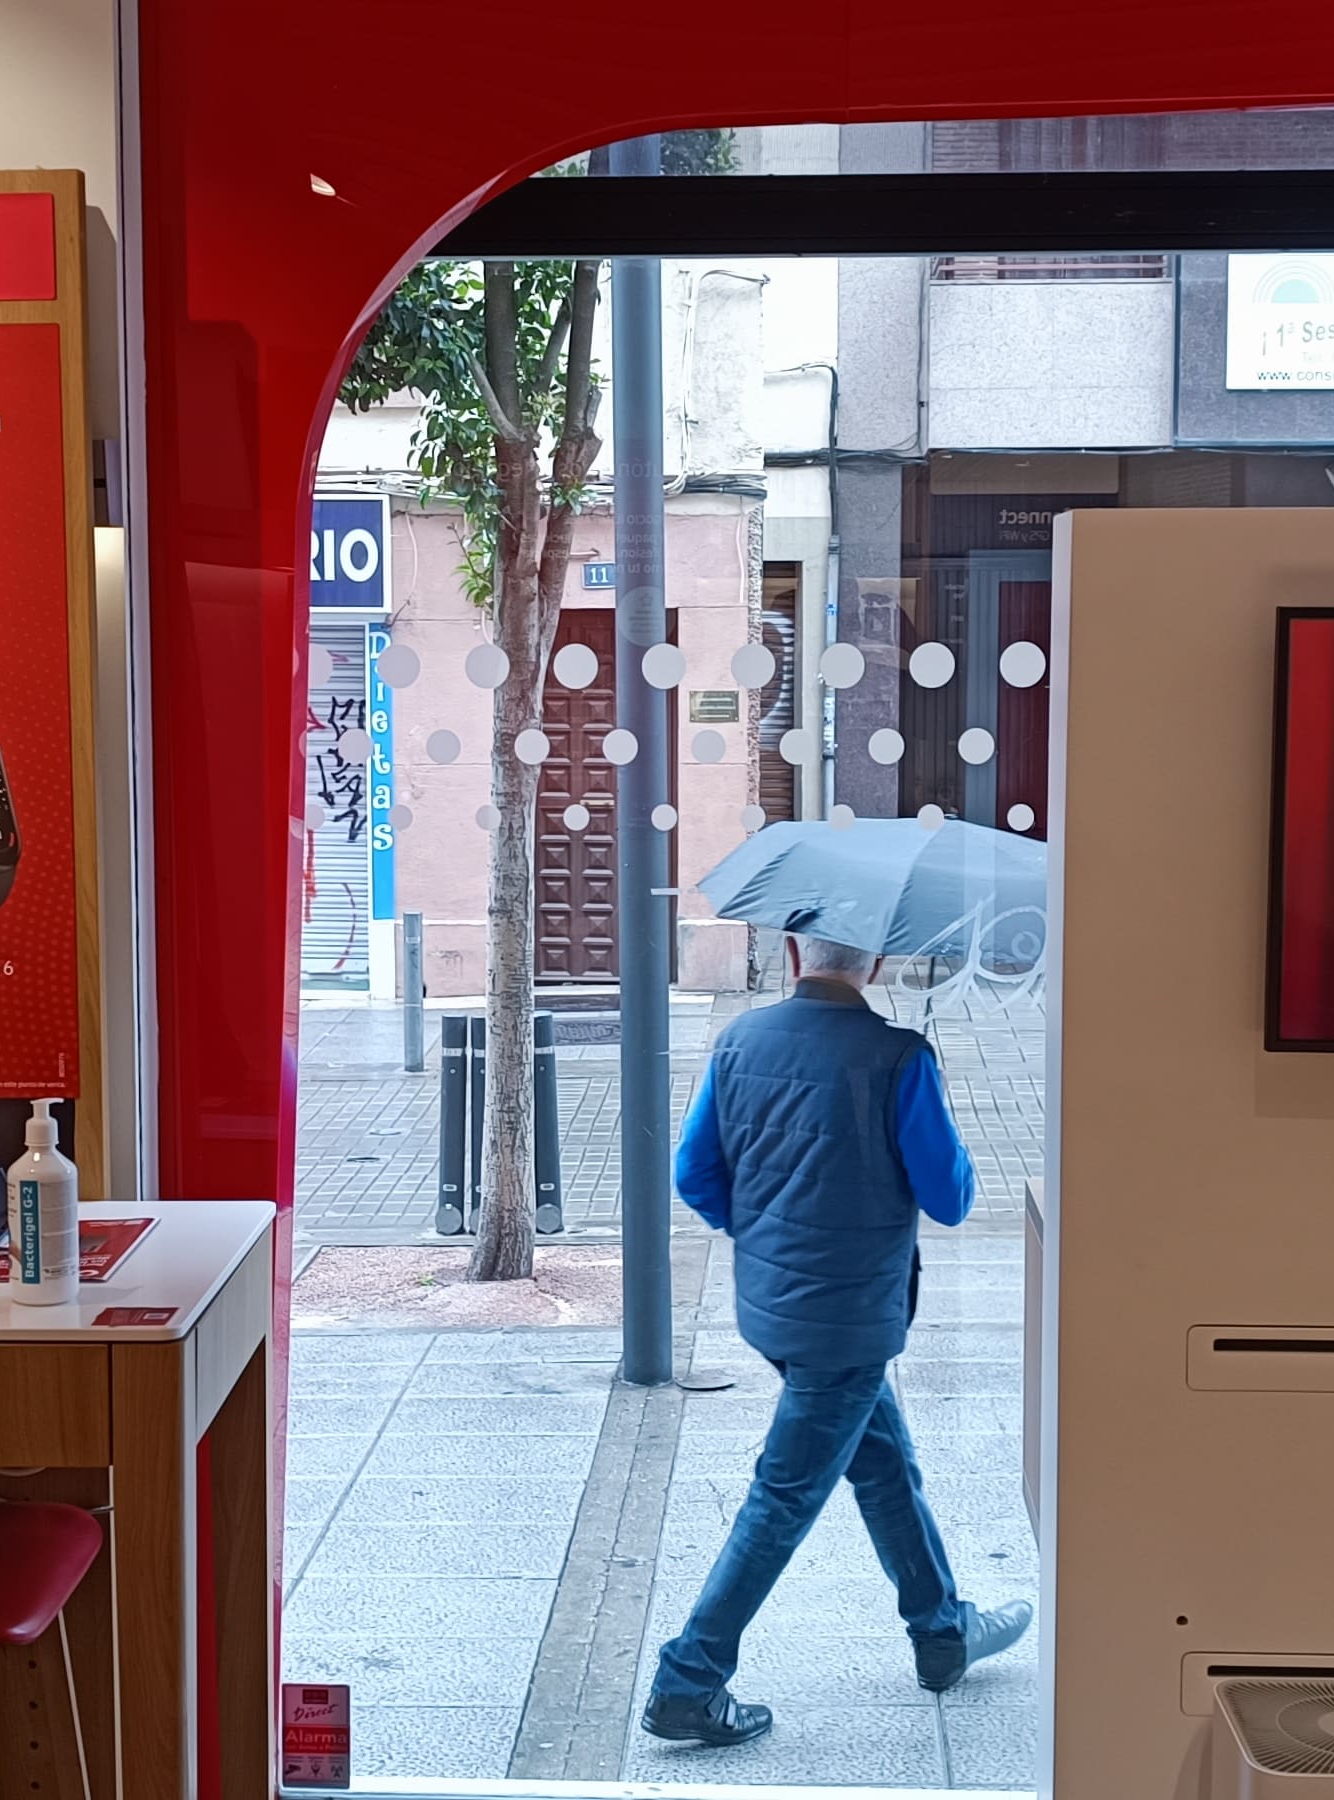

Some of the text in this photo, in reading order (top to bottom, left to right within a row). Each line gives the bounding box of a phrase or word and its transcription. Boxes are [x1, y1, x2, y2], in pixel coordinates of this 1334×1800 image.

[590, 567, 610, 584] 11
[369, 630, 394, 851] Dietas
[3, 961, 14, 976] 6
[22, 1186, 35, 1278] Bacterigel G-2
[285, 1729, 348, 1744] Alarma
